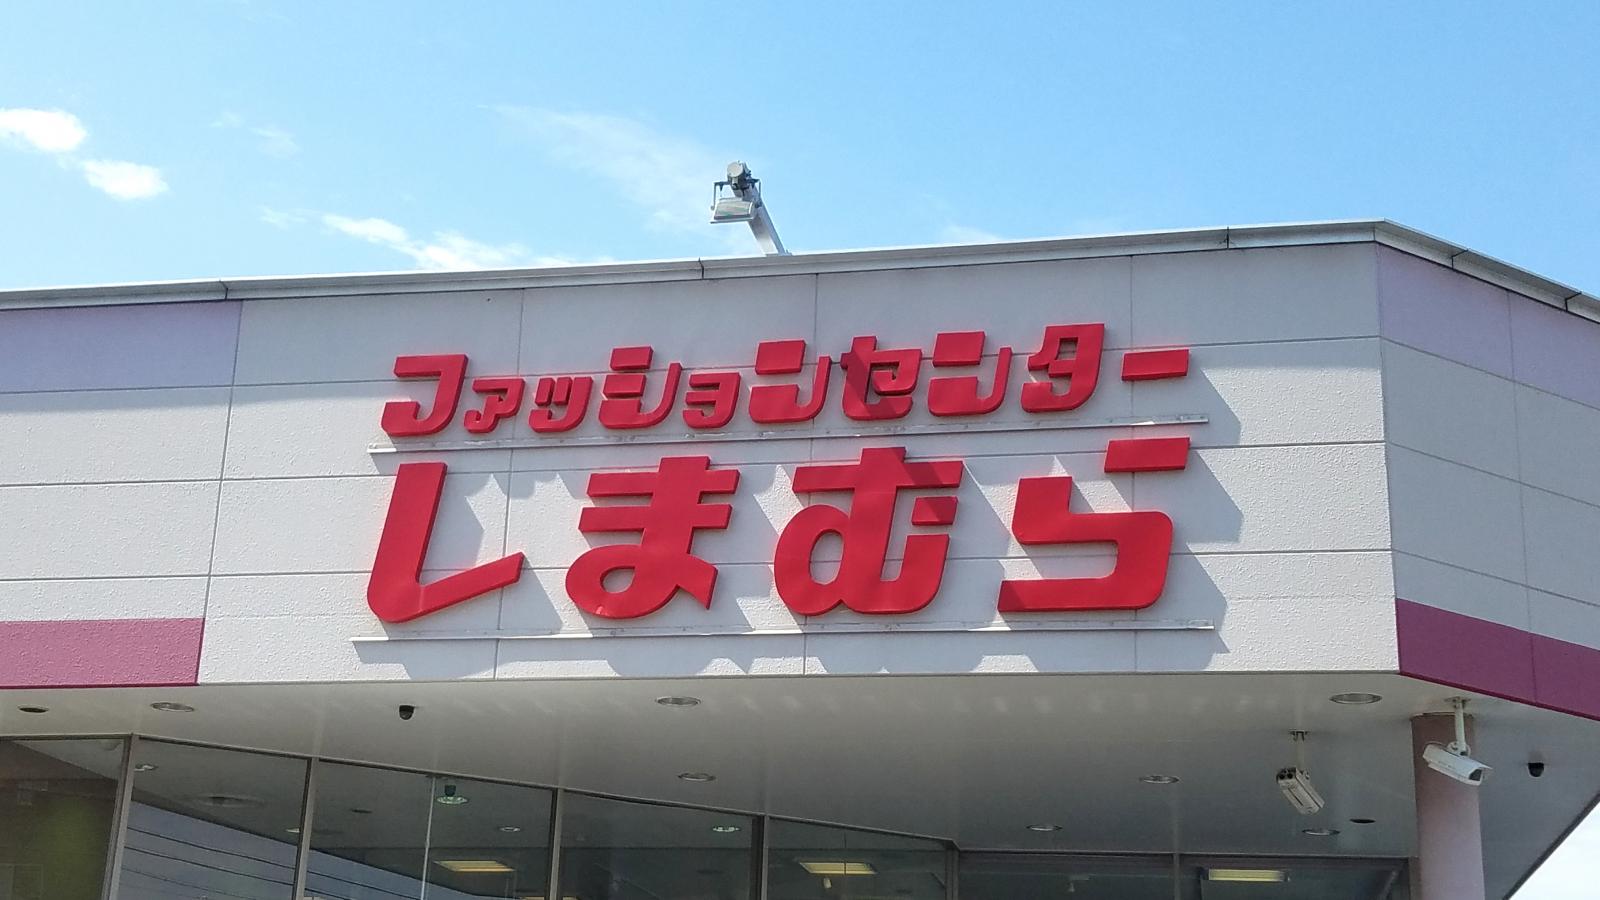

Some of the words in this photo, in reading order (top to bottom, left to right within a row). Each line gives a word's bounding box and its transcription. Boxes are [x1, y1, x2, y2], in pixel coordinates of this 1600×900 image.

[381, 323, 1190, 438] ファッションセンター
[366, 437, 1191, 624] しまむら
